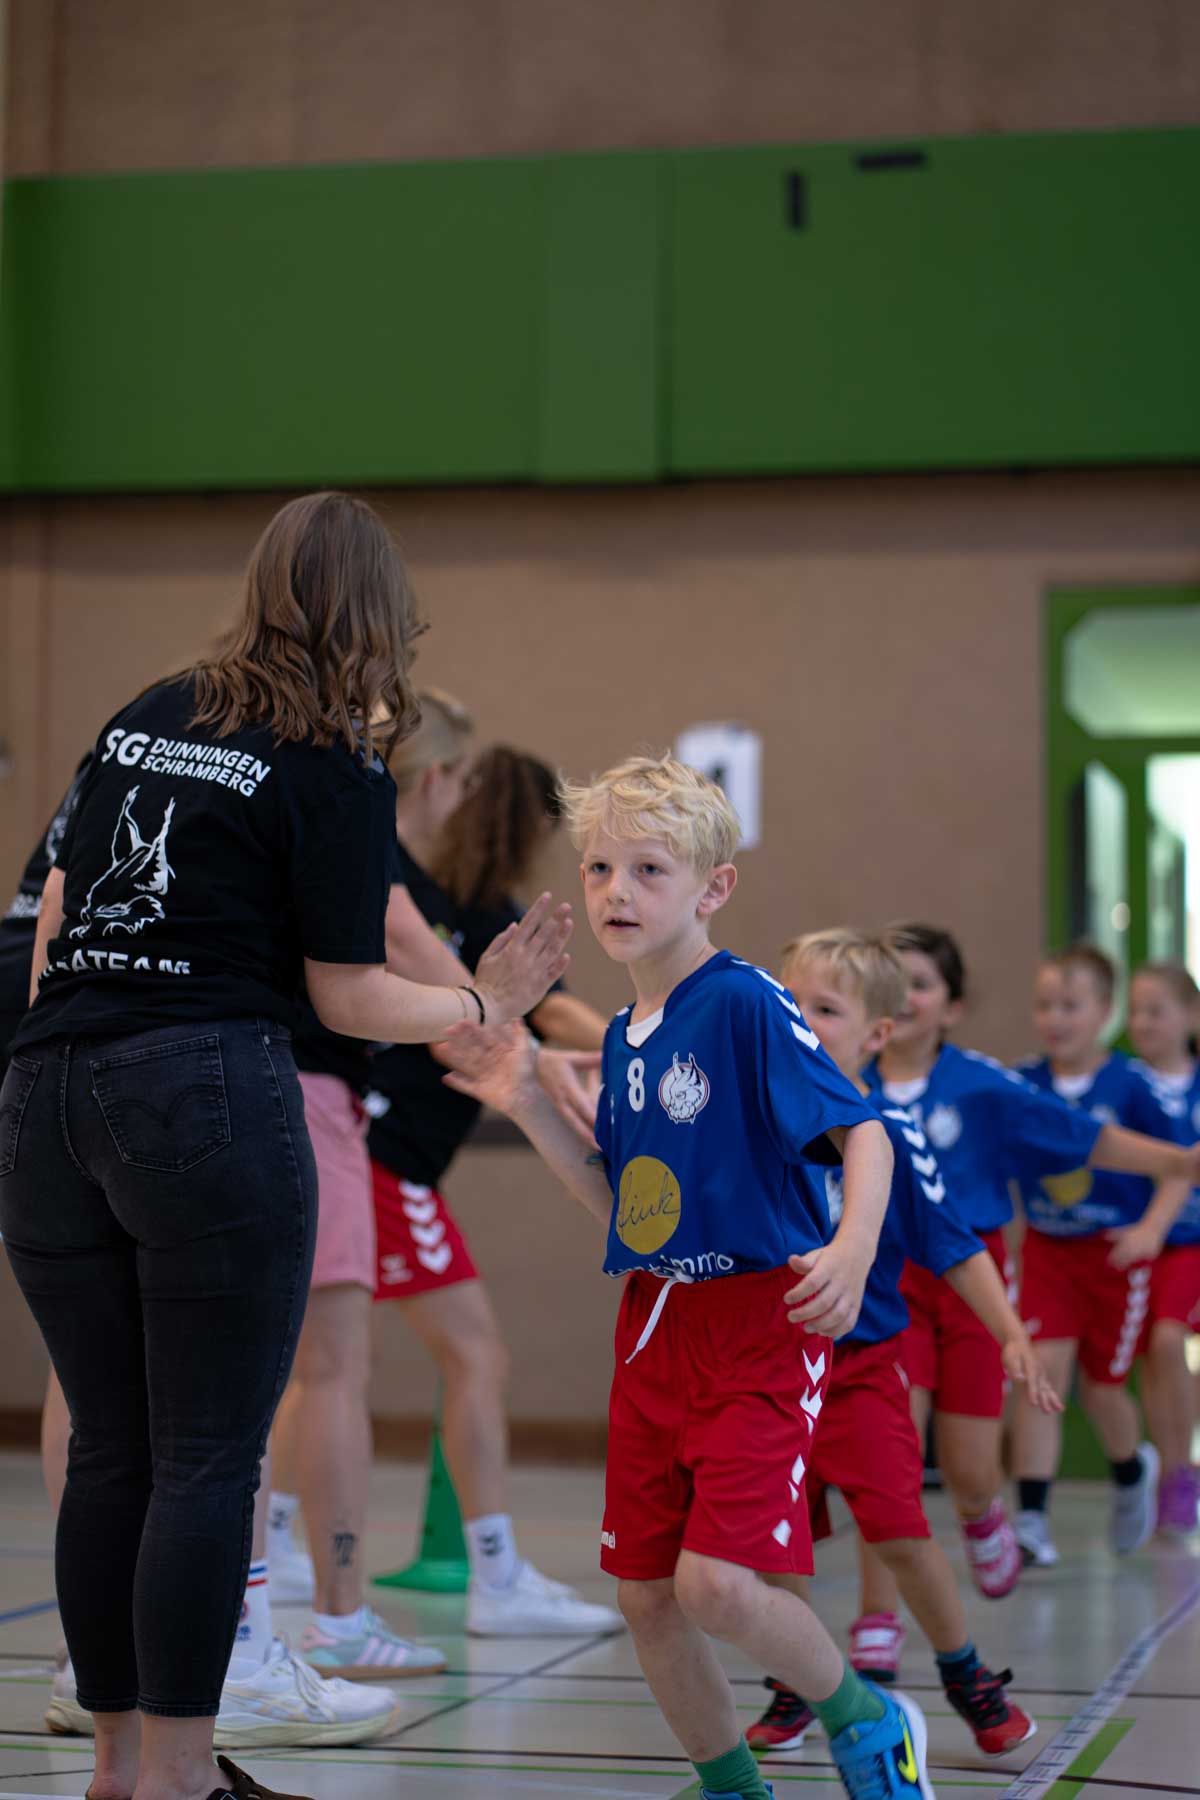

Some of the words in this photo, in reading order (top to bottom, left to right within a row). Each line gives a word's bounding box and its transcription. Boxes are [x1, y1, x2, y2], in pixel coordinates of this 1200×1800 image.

[101, 728, 151, 767] SG
[150, 737, 272, 783] DUNNINGEN
[140, 755, 257, 798] SCHRAMBERG
[626, 1057, 646, 1113] 8
